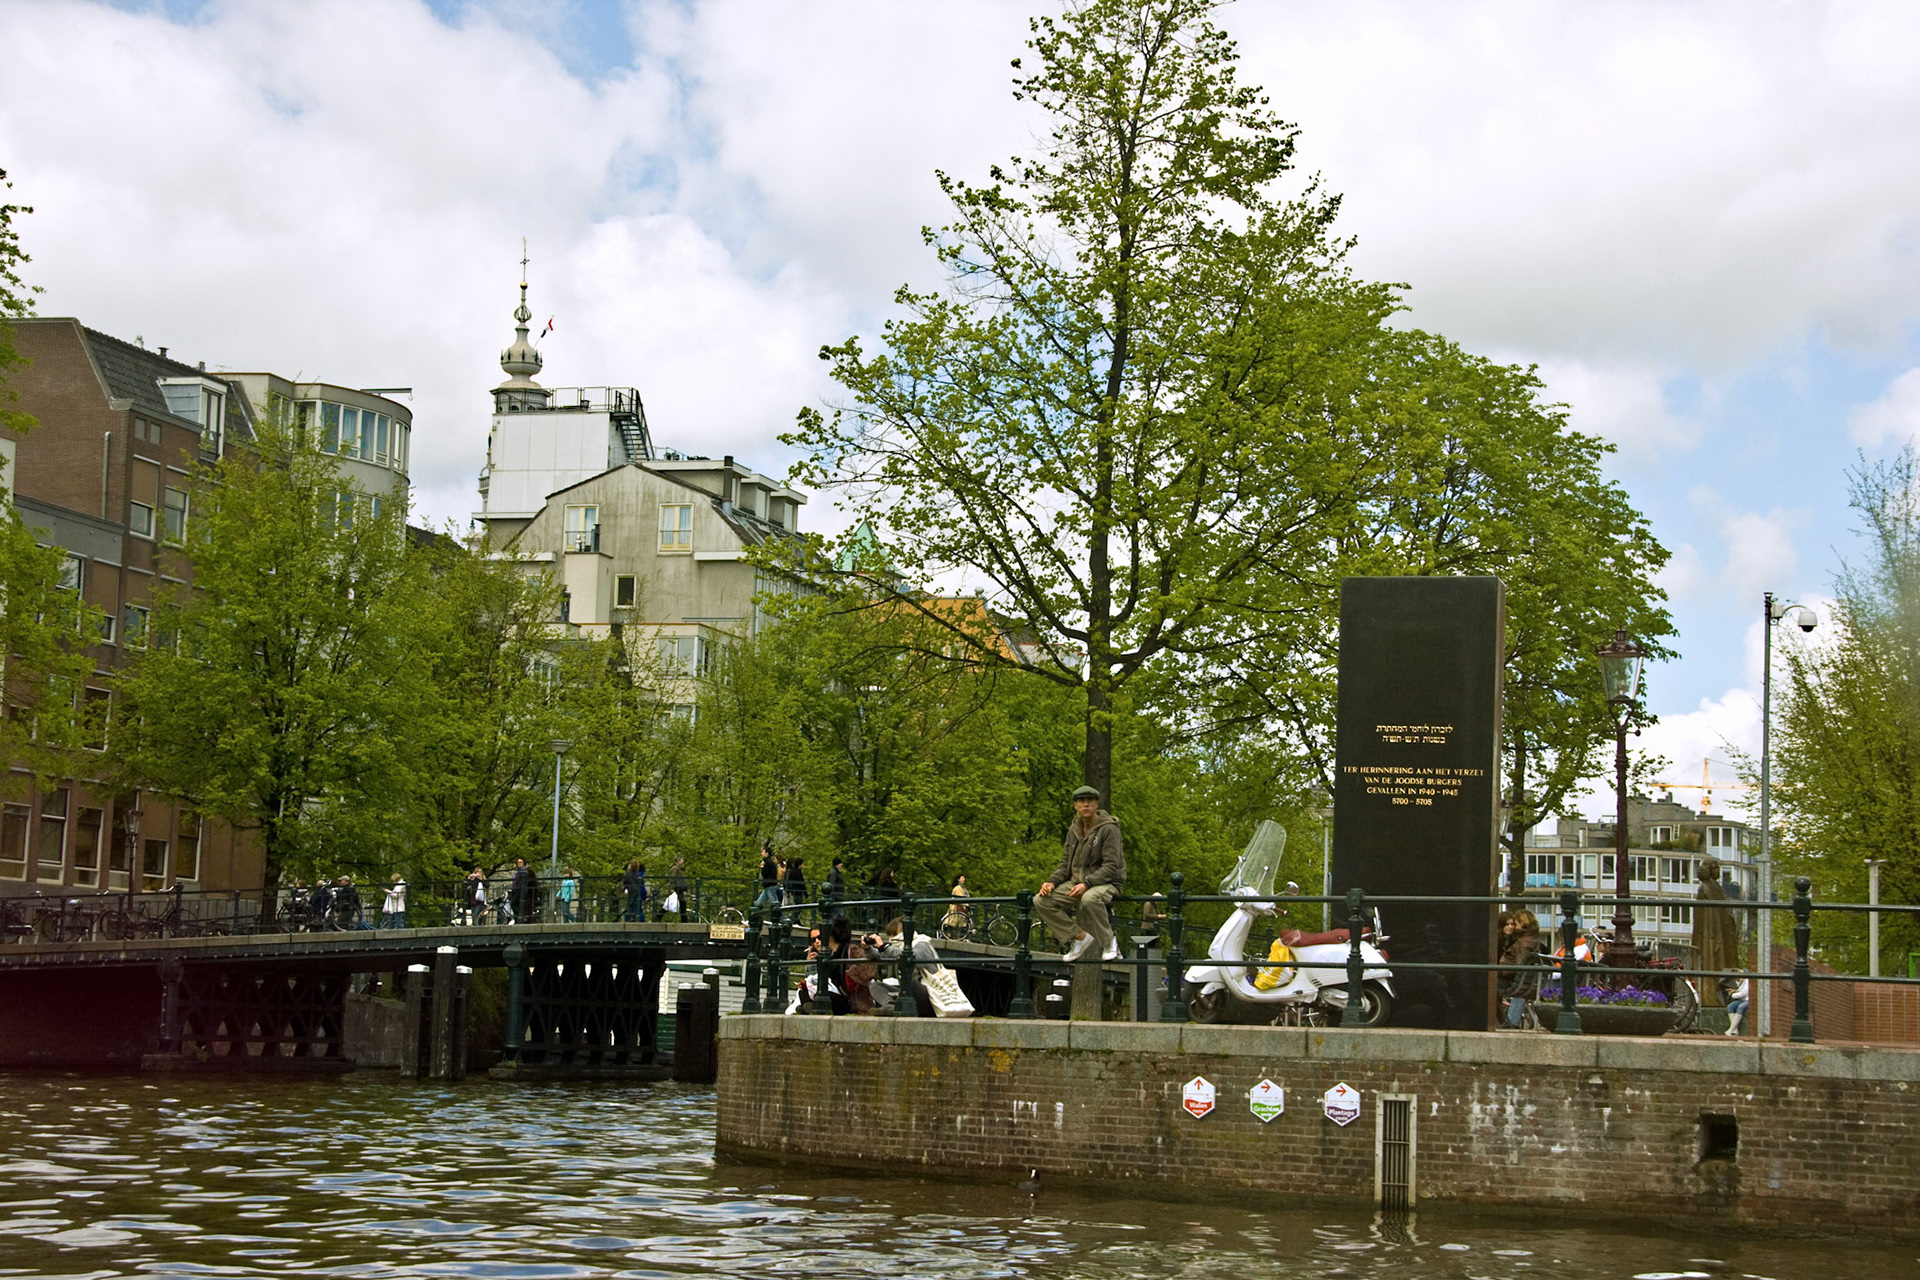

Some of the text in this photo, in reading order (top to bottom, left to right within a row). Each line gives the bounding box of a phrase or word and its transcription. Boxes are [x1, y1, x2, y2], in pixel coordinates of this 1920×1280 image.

[1360, 766, 1414, 775] HERINNERING
[1416, 767, 1433, 775] AAN
[1453, 768, 1484, 777] VERZET
[1364, 776, 1379, 784] VAN
[1394, 777, 1424, 785] JOODSE
[1427, 778, 1462, 786] BURGERS
[1366, 787, 1405, 795] GEVALLEN
[1415, 798, 1432, 806] 5705
[1328, 1108, 1355, 1118] Plantage
